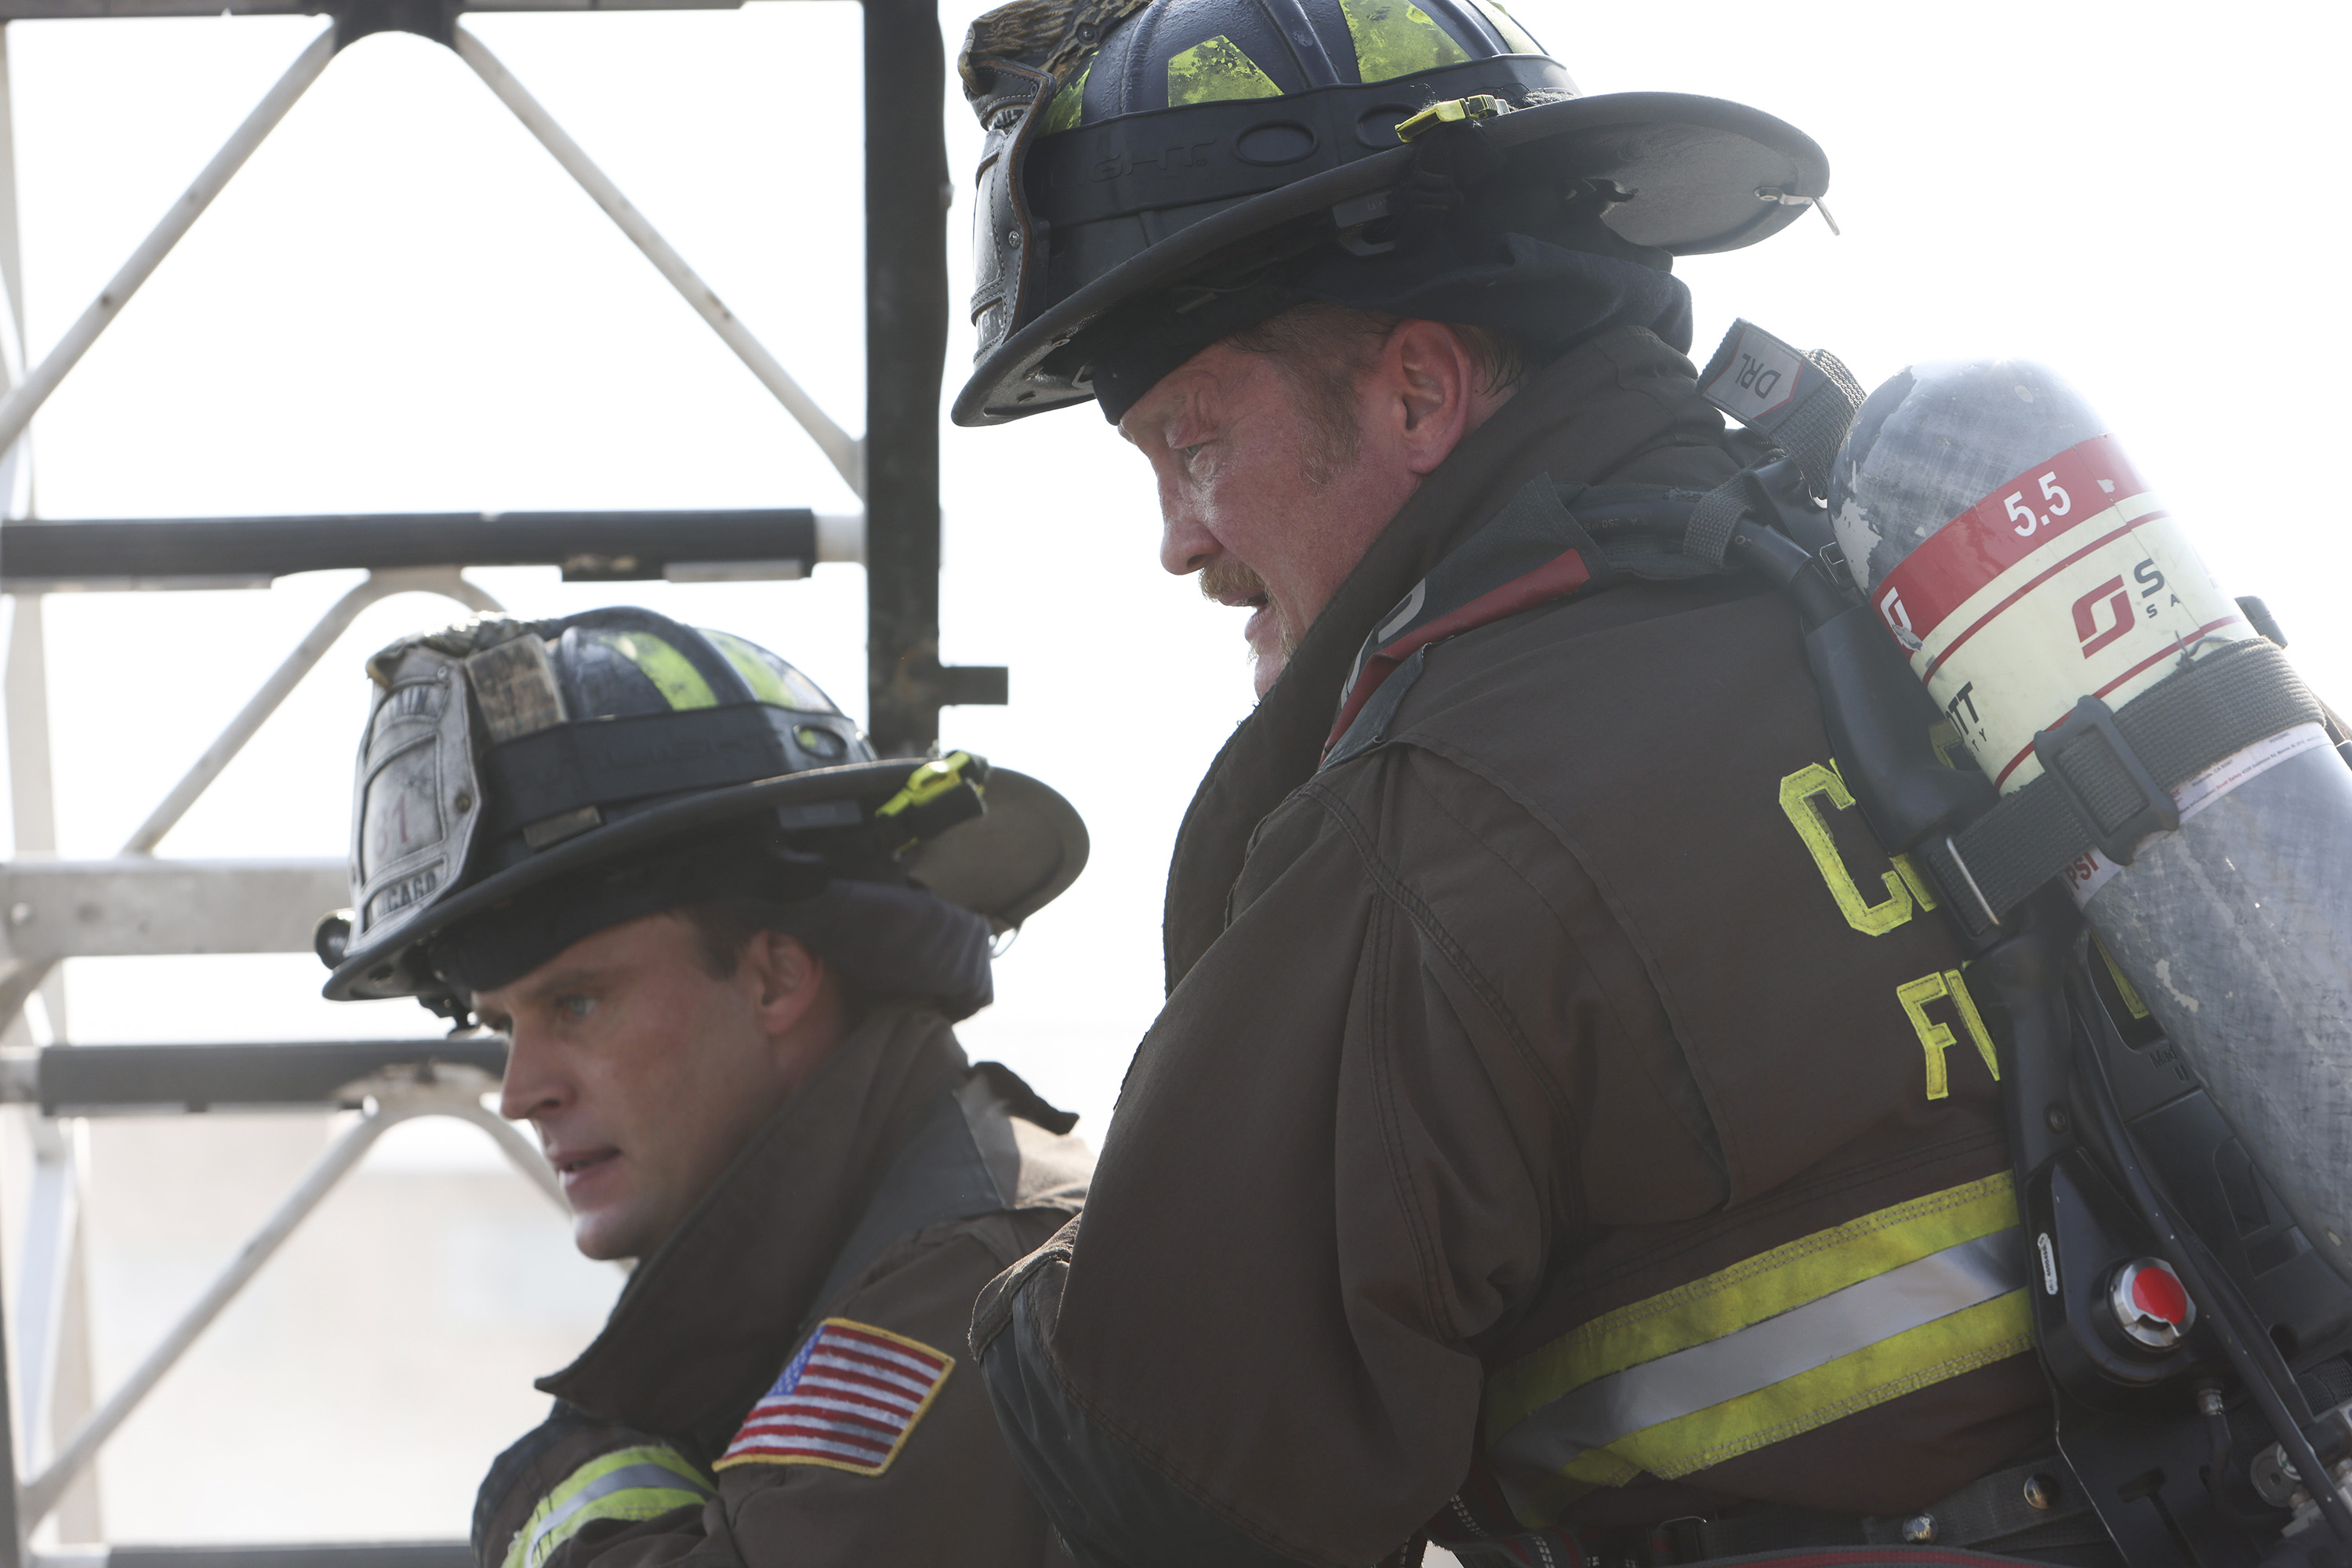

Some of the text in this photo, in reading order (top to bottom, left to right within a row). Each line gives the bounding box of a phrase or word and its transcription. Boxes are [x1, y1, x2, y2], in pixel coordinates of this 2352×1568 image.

[1735, 353, 1782, 400] DRL
[2003, 470, 2071, 537] 5.5
[2064, 851, 2100, 891] PSI
